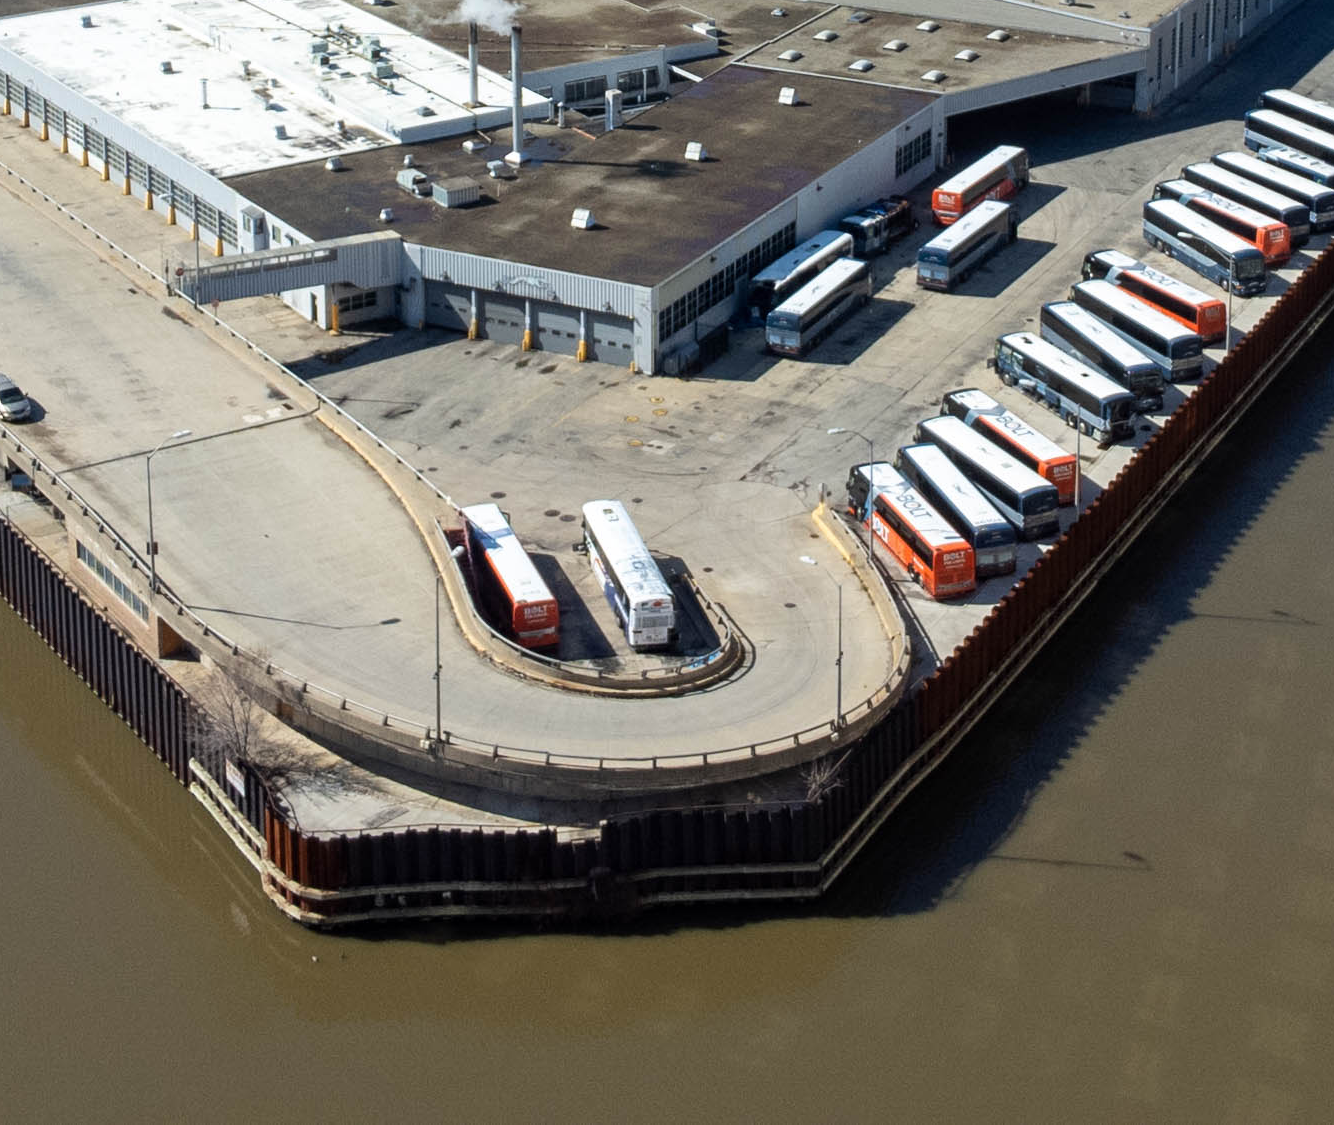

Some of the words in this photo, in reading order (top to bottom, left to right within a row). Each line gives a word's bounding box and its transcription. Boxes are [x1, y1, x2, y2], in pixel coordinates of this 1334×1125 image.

[1143, 269, 1180, 286] BOLT
[996, 415, 1034, 436] BOLT
[1053, 464, 1072, 475] BOLT
[897, 491, 932, 518] BOLT
[943, 551, 966, 561] BOLT
[524, 605, 548, 616] BOLT
